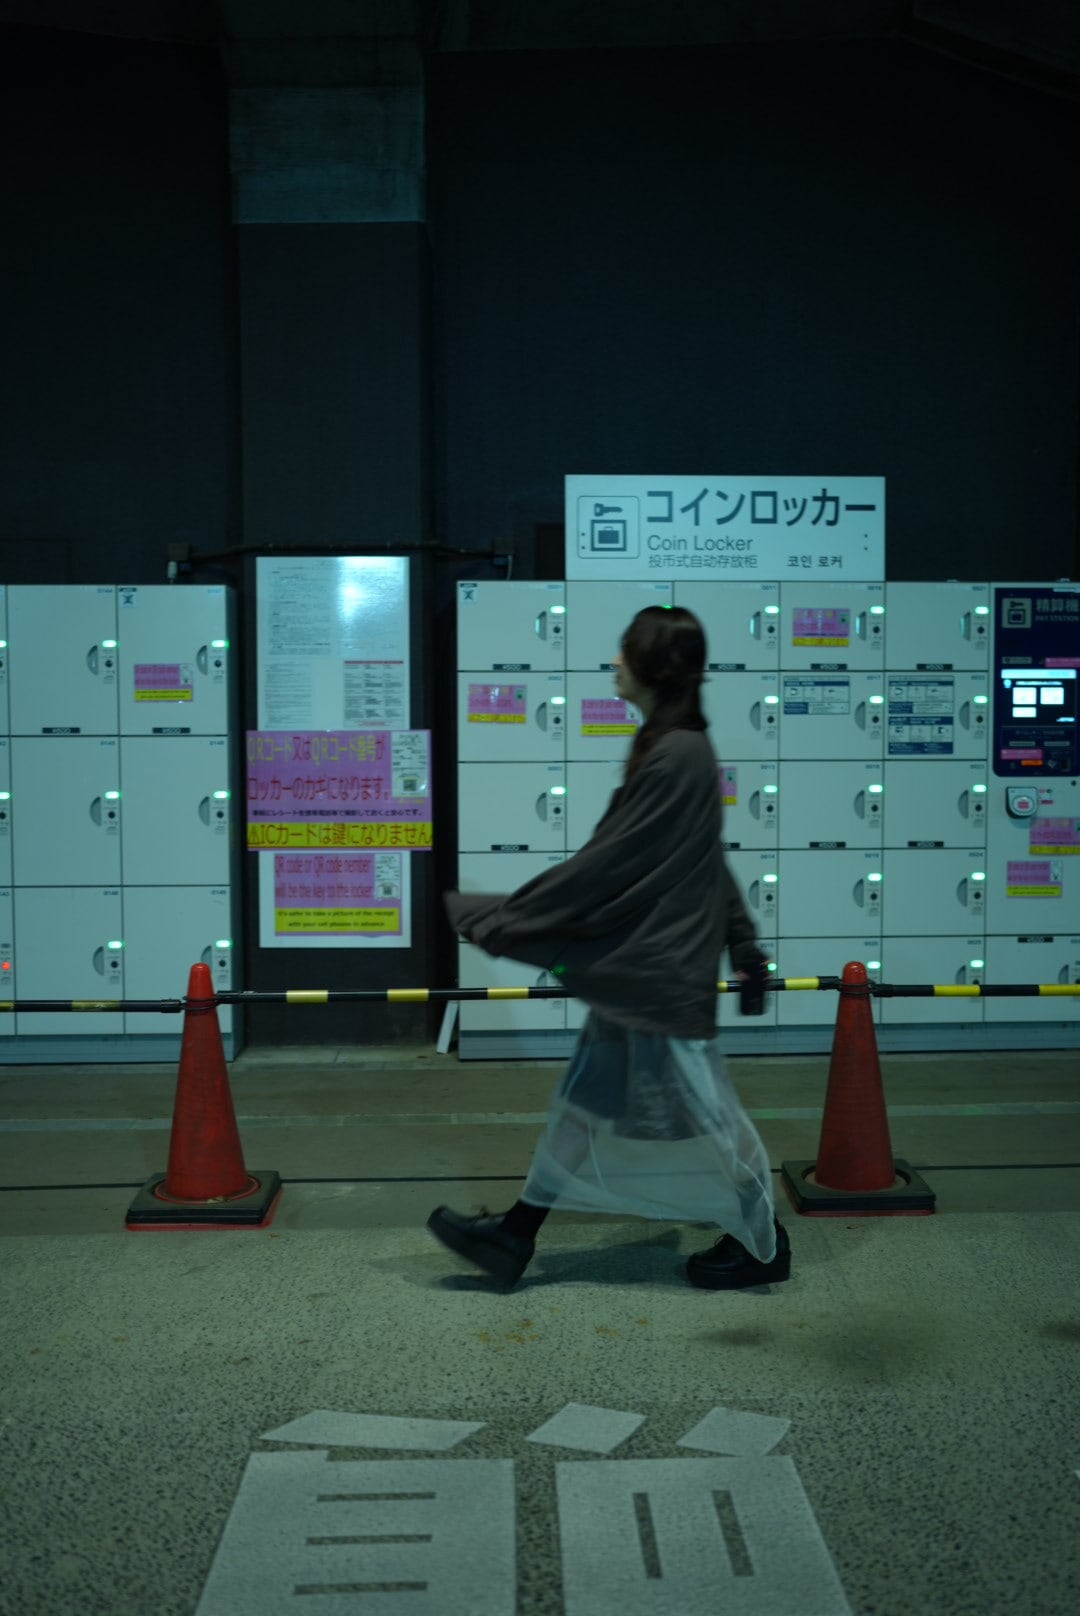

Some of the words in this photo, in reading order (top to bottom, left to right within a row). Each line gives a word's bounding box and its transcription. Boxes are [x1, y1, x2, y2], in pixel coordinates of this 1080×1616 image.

[646, 488, 876, 526] コインロッカー
[647, 534, 688, 551] Coin
[694, 535, 753, 551] Locker
[648, 554, 757, 568] 投币式自动存放柜
[787, 555, 812, 568] 코인
[818, 555, 844, 568] 로커
[247, 776, 389, 801] ロッカーのカギになります。
